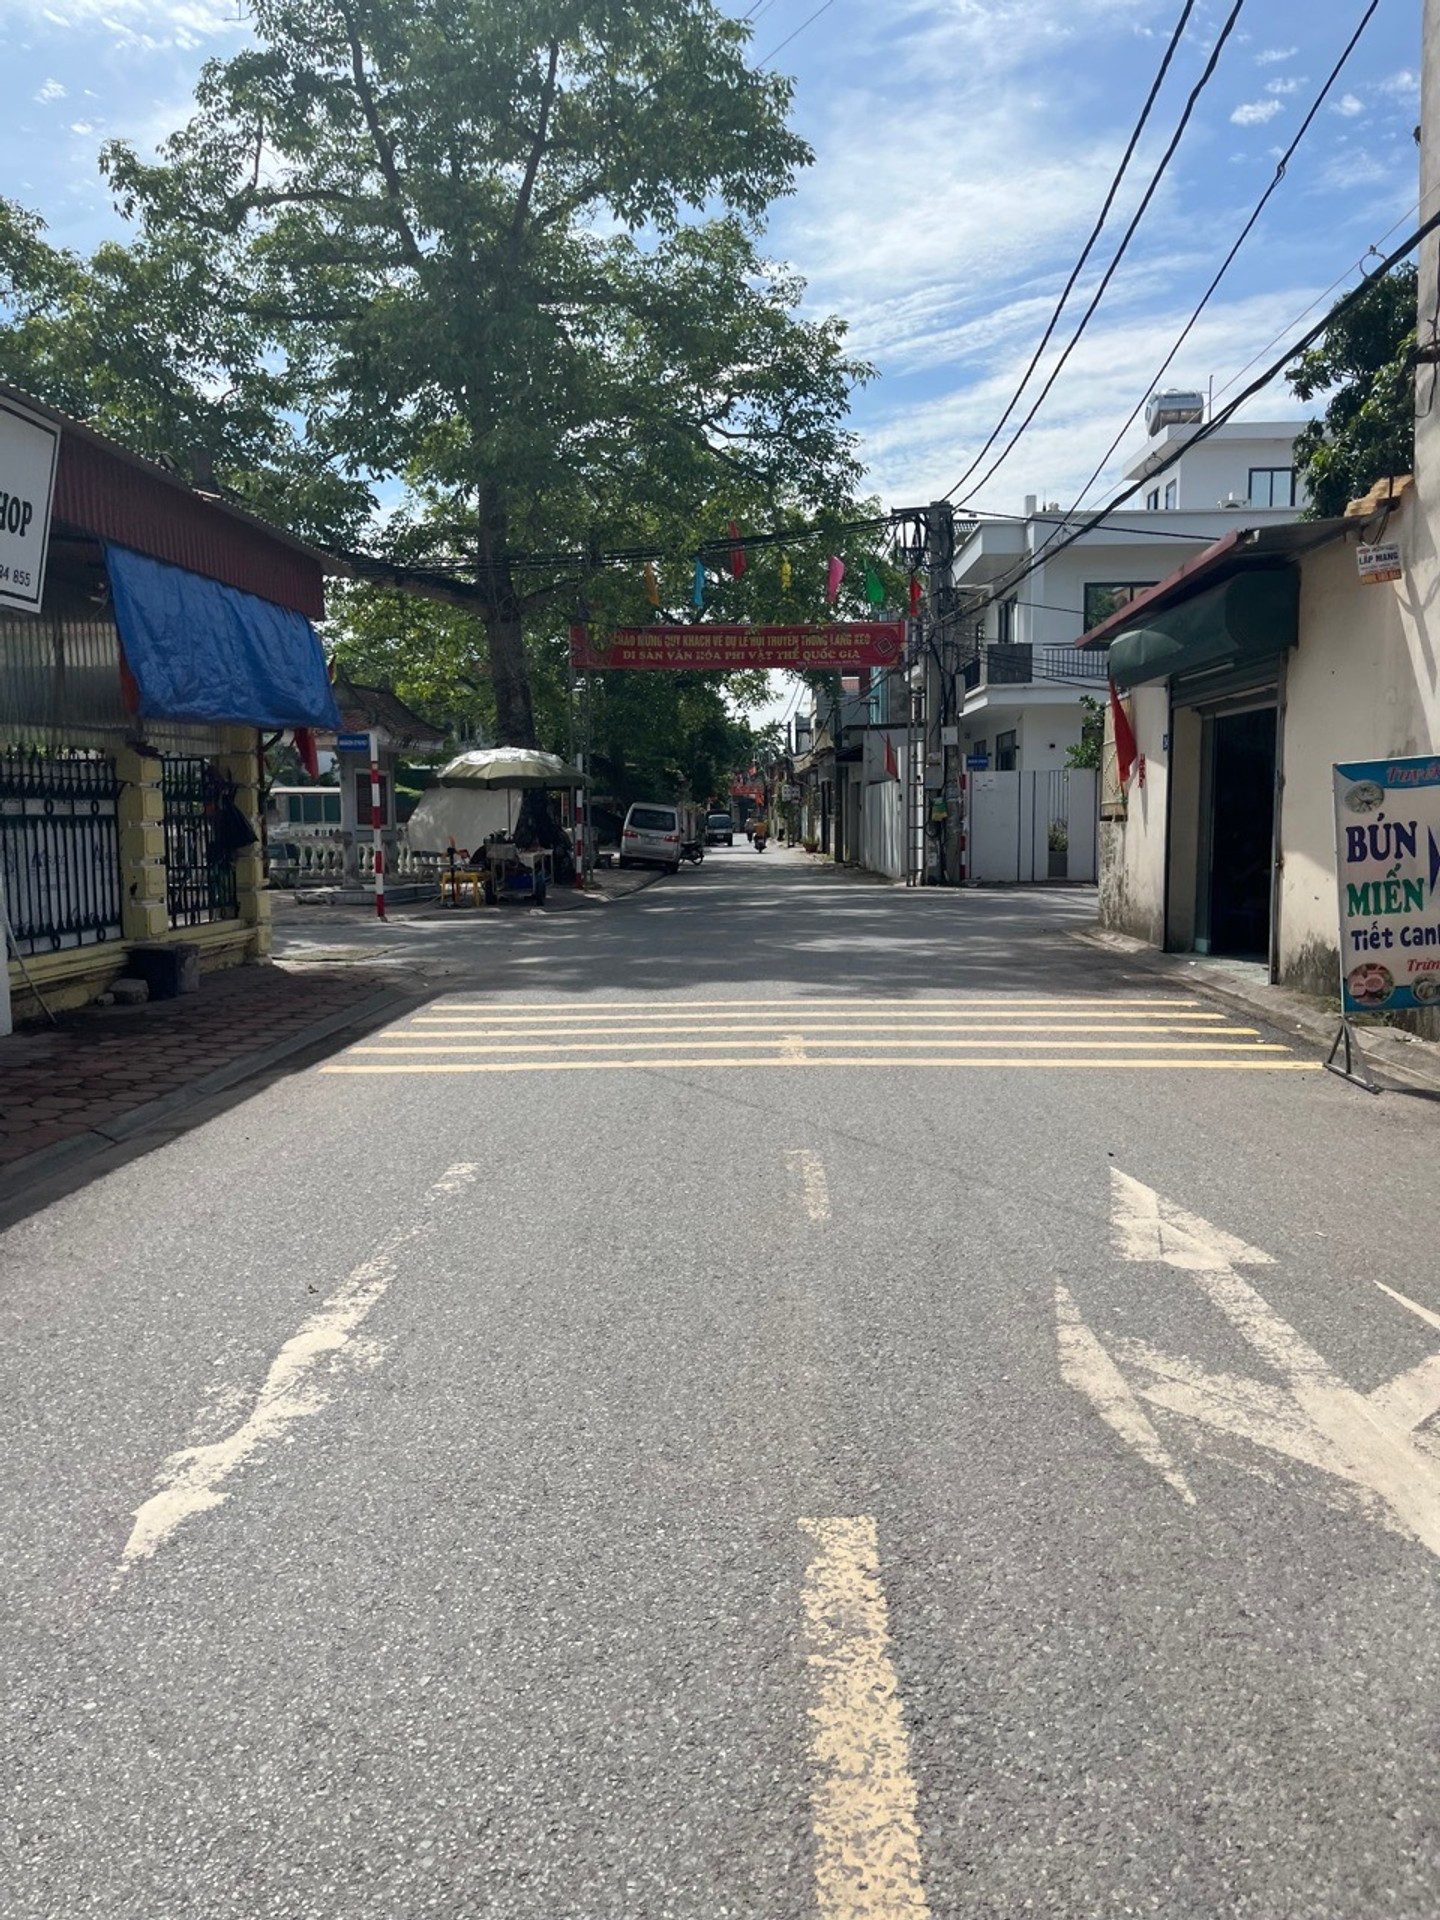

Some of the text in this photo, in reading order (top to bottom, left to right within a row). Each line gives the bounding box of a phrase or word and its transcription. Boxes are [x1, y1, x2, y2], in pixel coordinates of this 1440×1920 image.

[13, 569, 31, 587] 855
[623, 651, 636, 659] DI
[639, 648, 663, 660] SẢN
[667, 649, 693, 660] VĂN
[724, 651, 745, 660] PHI
[749, 649, 774, 662] VẬT
[803, 647, 836, 661] QUỐC
[838, 650, 860, 659] GIA
[1346, 812, 1418, 863] BÚN
[1347, 863, 1425, 917] MIẾN
[1351, 921, 1440, 951] Tiết Can
